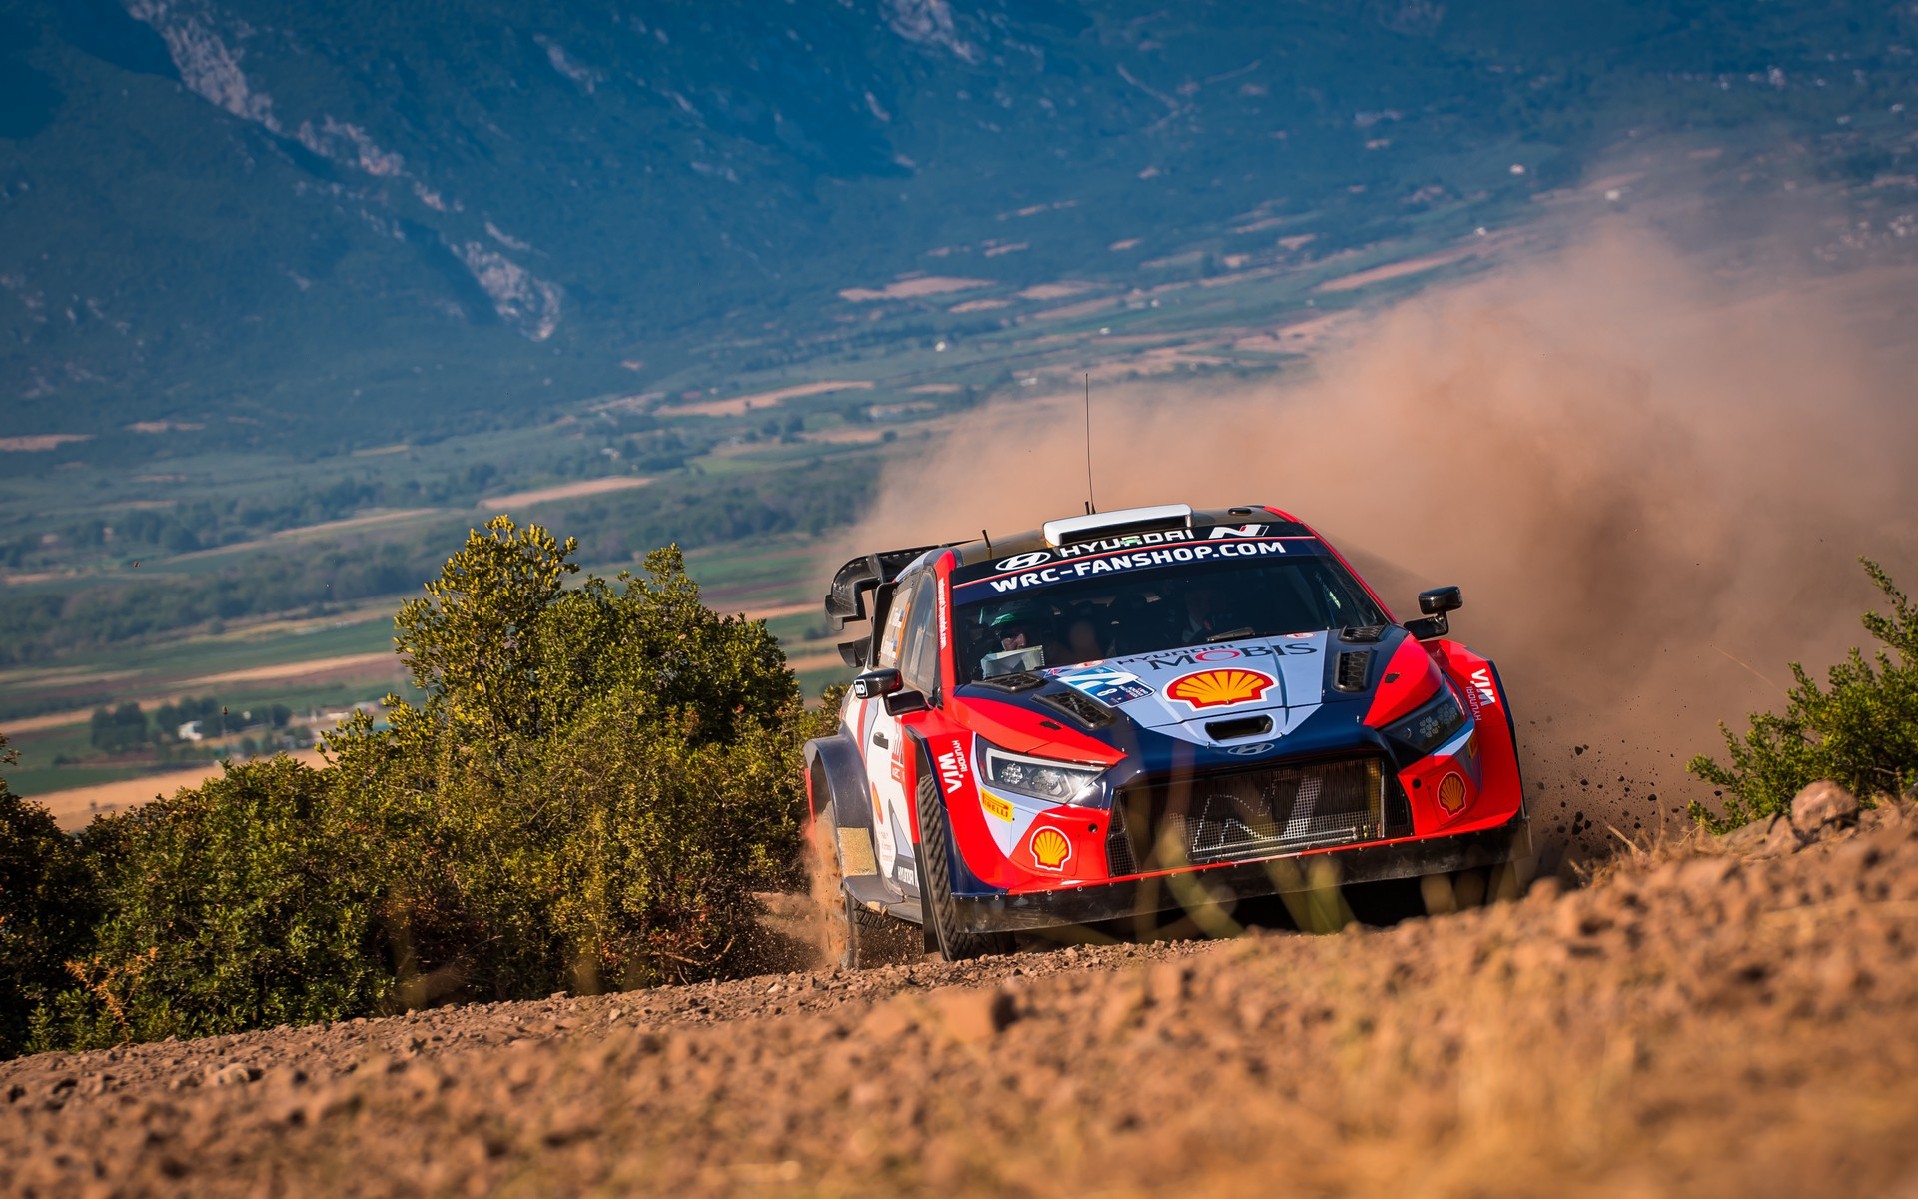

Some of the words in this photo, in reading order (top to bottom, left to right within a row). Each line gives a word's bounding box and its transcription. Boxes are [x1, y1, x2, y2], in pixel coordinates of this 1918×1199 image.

[1060, 529, 1195, 558] HYUNDAI
[990, 541, 1287, 593] WRC-FANSHOP.COM
[1117, 644, 1235, 665] HYUNDAI
[1147, 642, 1318, 671] MOBIS
[1465, 686, 1482, 721] HYUNDAI
[952, 739, 968, 773] HYUNDAI
[981, 792, 1009, 818] PIRELLI
